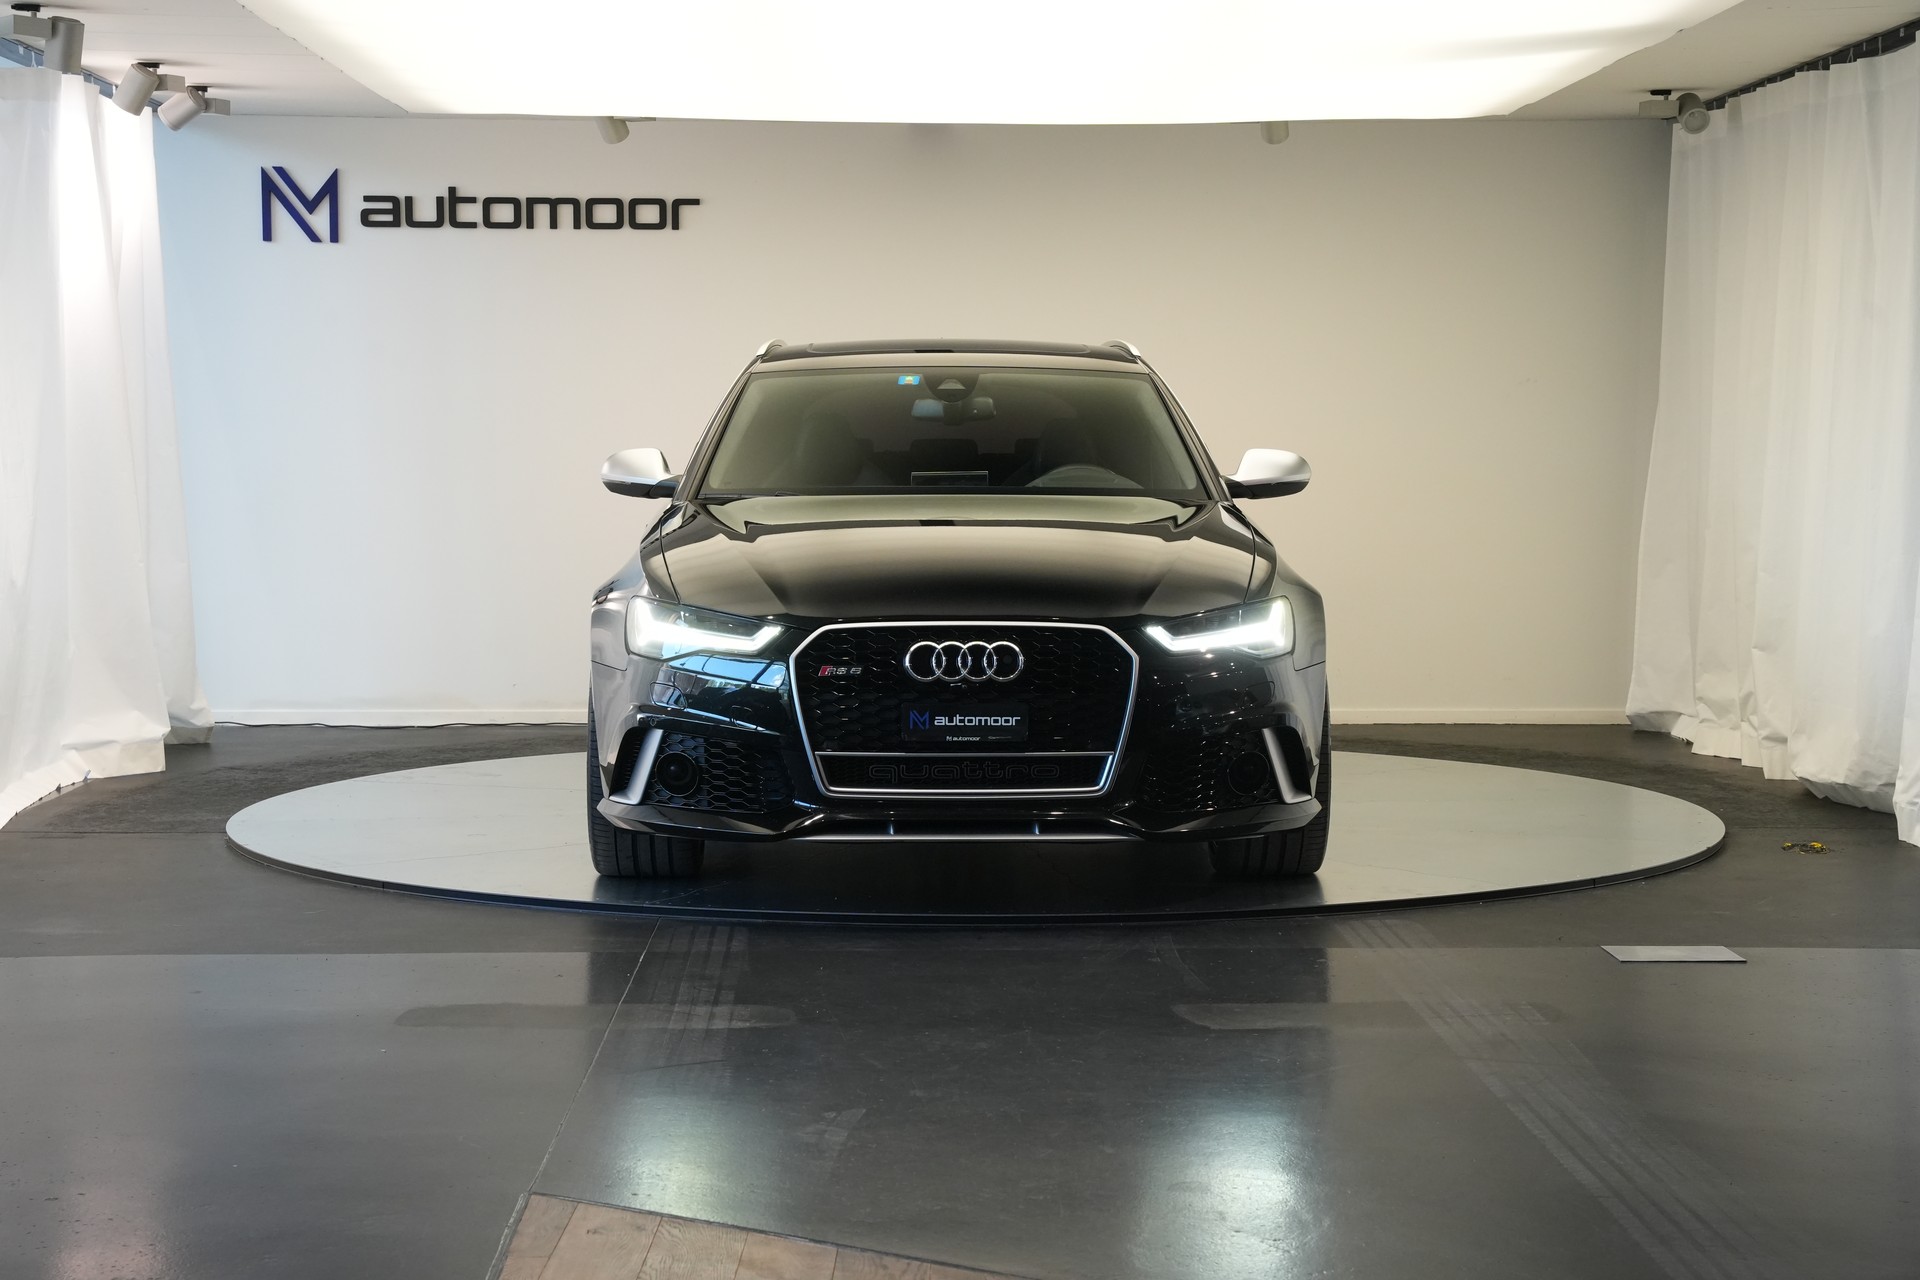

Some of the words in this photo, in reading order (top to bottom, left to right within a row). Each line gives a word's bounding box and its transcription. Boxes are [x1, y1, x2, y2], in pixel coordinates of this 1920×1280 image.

[360, 186, 701, 231] automoor
[825, 667, 848, 675] RS
[934, 713, 1021, 726] automoor
[868, 761, 1060, 784] quattro
